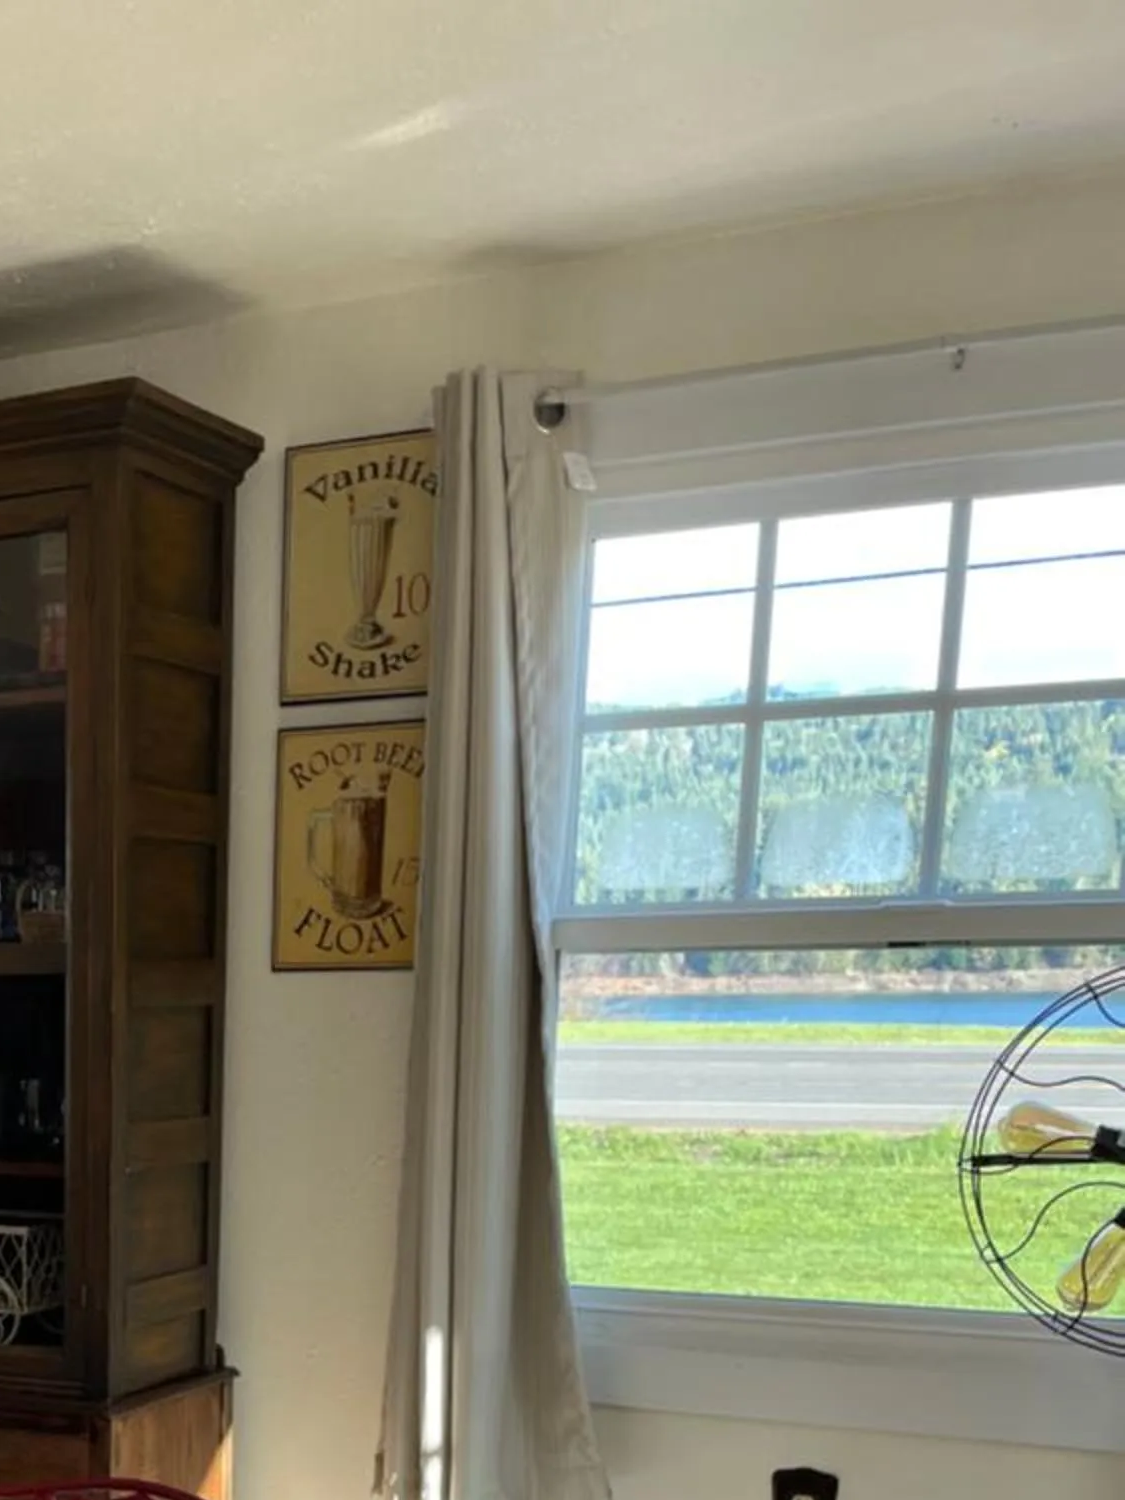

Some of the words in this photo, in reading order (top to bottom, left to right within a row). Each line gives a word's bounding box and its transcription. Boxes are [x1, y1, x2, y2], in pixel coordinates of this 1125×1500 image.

[303, 454, 439, 503] Vanilla
[308, 641, 422, 680] Shake
[288, 742, 366, 790] ROOT
[293, 905, 410, 956] FLOAT
